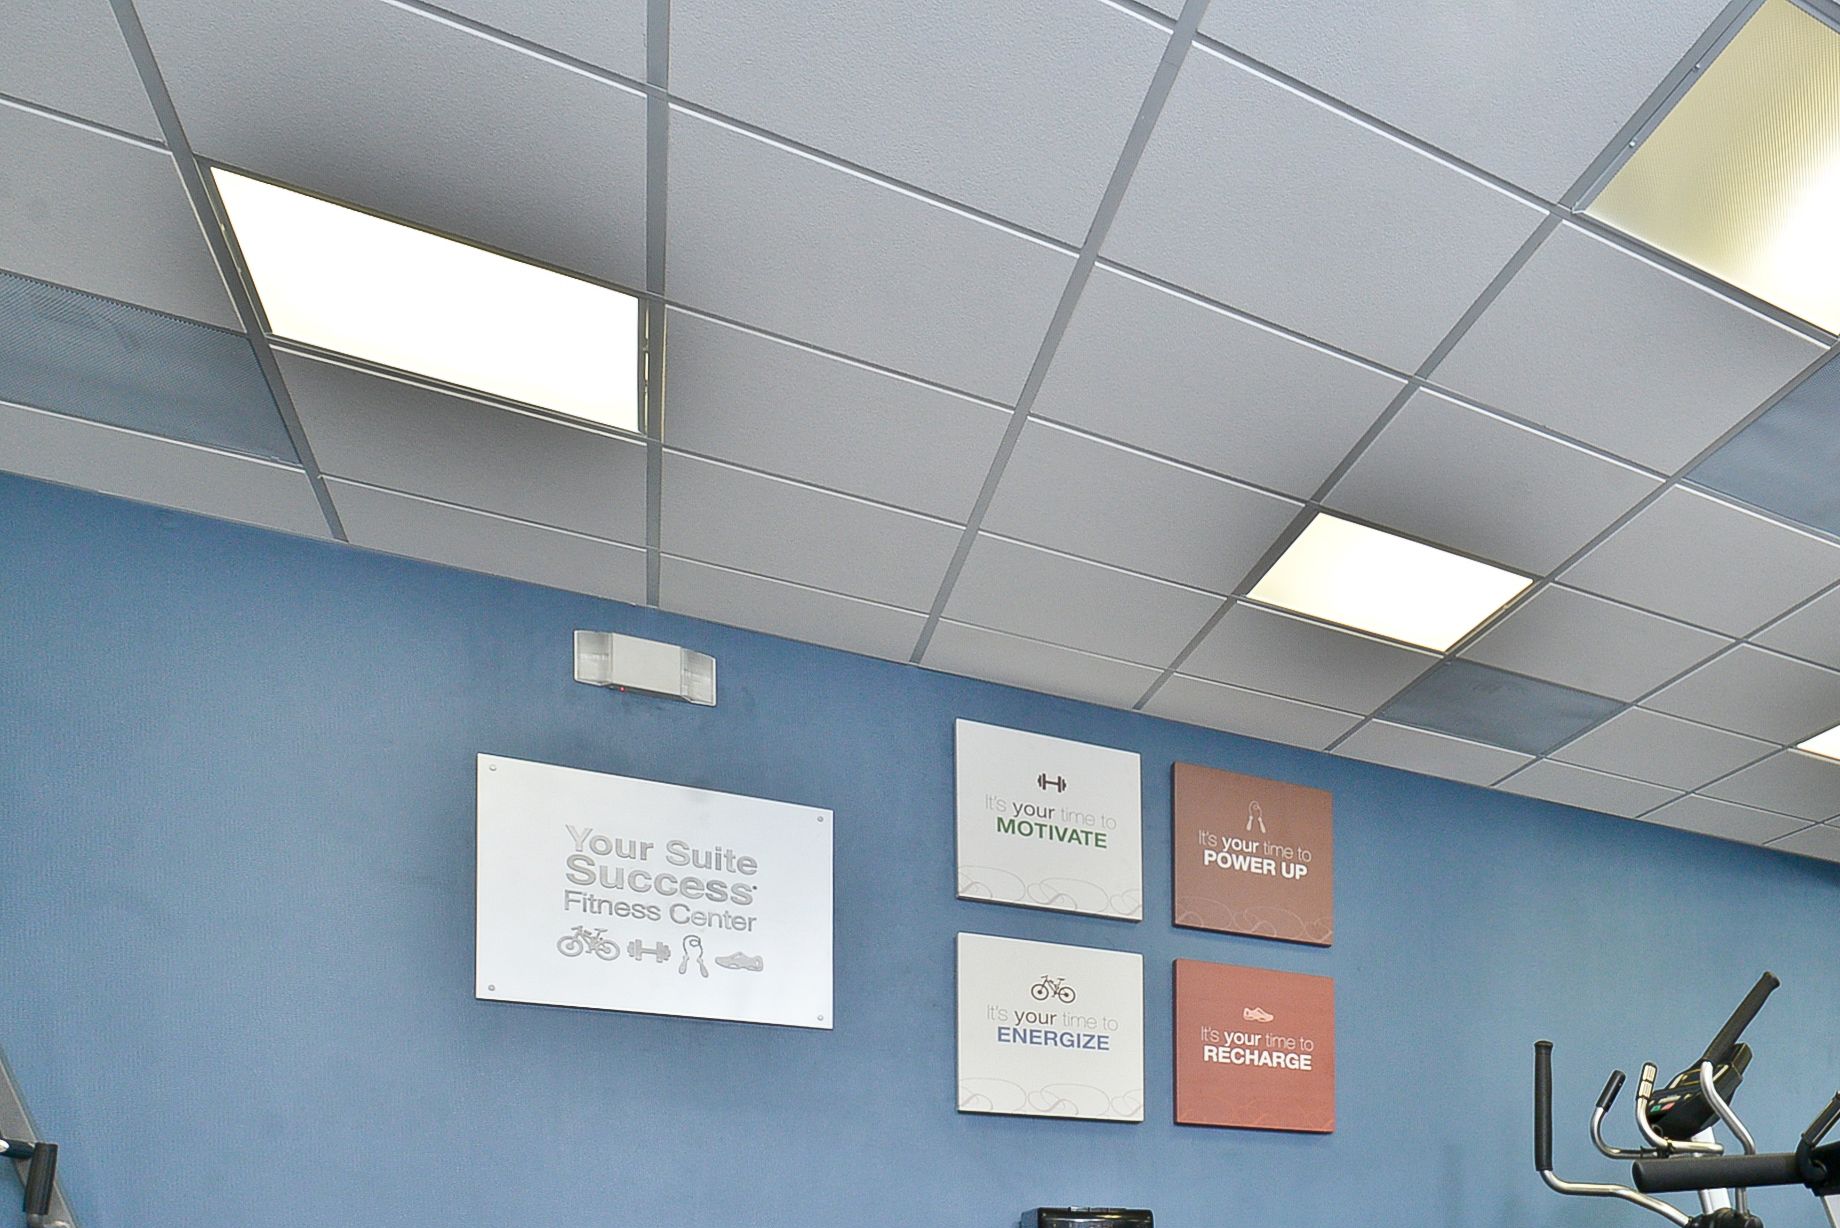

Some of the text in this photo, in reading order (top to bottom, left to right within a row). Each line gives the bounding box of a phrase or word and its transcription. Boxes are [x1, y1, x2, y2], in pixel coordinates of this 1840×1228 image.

[985, 794, 1117, 830] It's your time to
[996, 816, 1108, 848] MOTIVATE
[1198, 829, 1312, 862] It's your time to
[565, 824, 758, 875] Your Suite
[1203, 849, 1308, 880] POWER UP
[566, 854, 754, 905] Success
[564, 889, 757, 931] Fitness Center
[986, 1004, 1119, 1032] It's your time to
[997, 1026, 1110, 1050] ENERGIZE
[1201, 1025, 1315, 1052] It's your time to
[1203, 1045, 1312, 1071] RECHARGE
